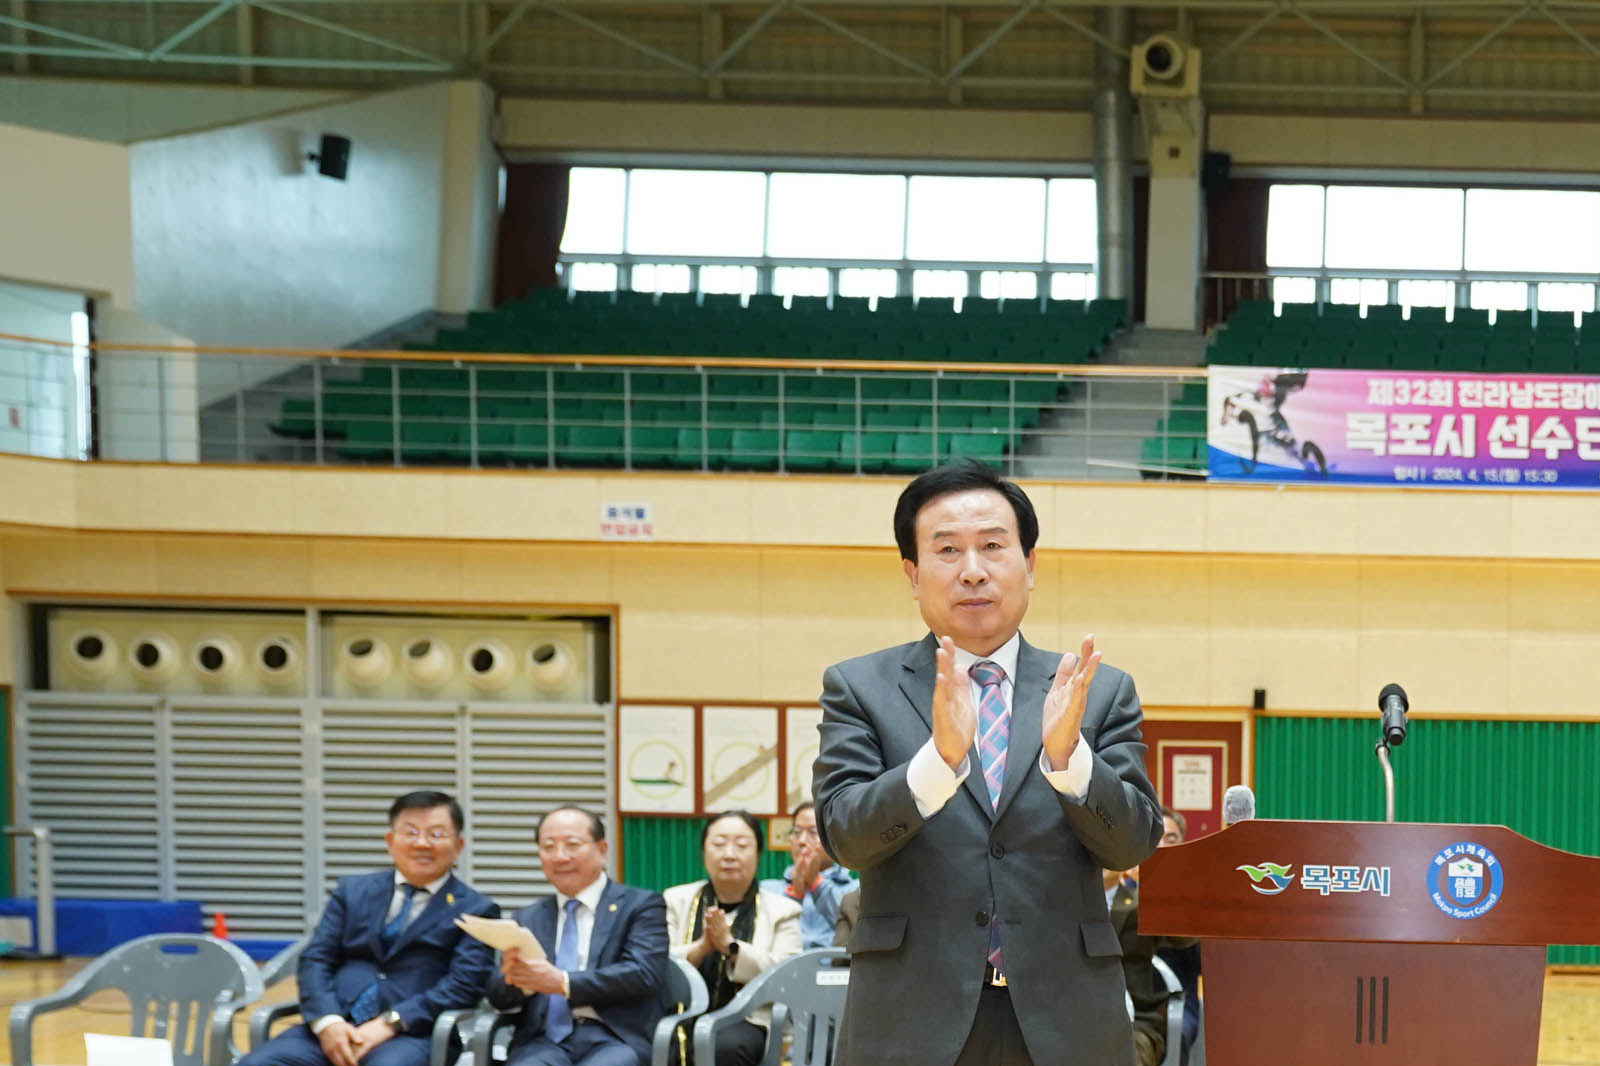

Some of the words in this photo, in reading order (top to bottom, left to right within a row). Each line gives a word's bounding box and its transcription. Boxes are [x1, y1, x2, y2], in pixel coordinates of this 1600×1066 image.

[1367, 378, 1454, 407] 제32회
[1345, 412, 1476, 459] 목포시
[1300, 864, 1391, 897] 목포시
